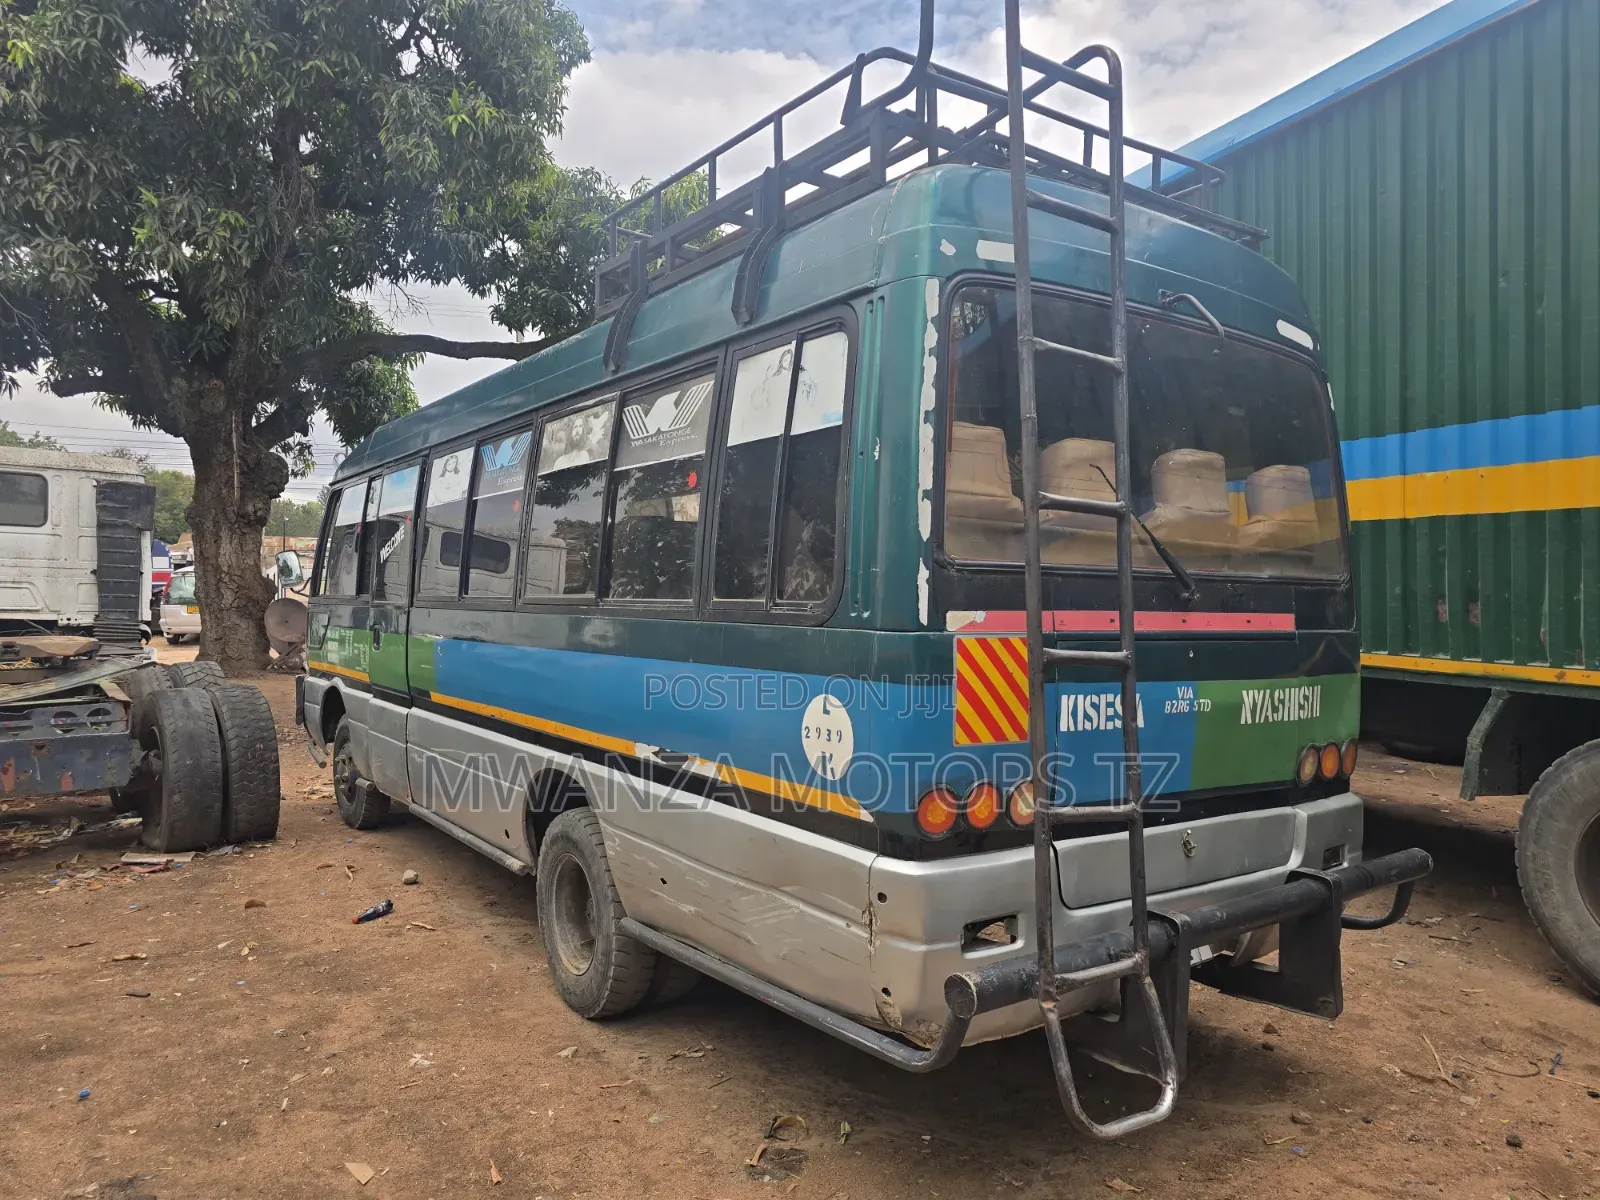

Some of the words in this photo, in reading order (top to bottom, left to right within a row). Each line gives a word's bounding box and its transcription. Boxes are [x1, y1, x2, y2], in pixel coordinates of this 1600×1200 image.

[1177, 686, 1194, 699] VIA
[1193, 699, 1212, 712] STD
[1240, 685, 1321, 724] NYASHISHI
[804, 726, 843, 743] 2939
